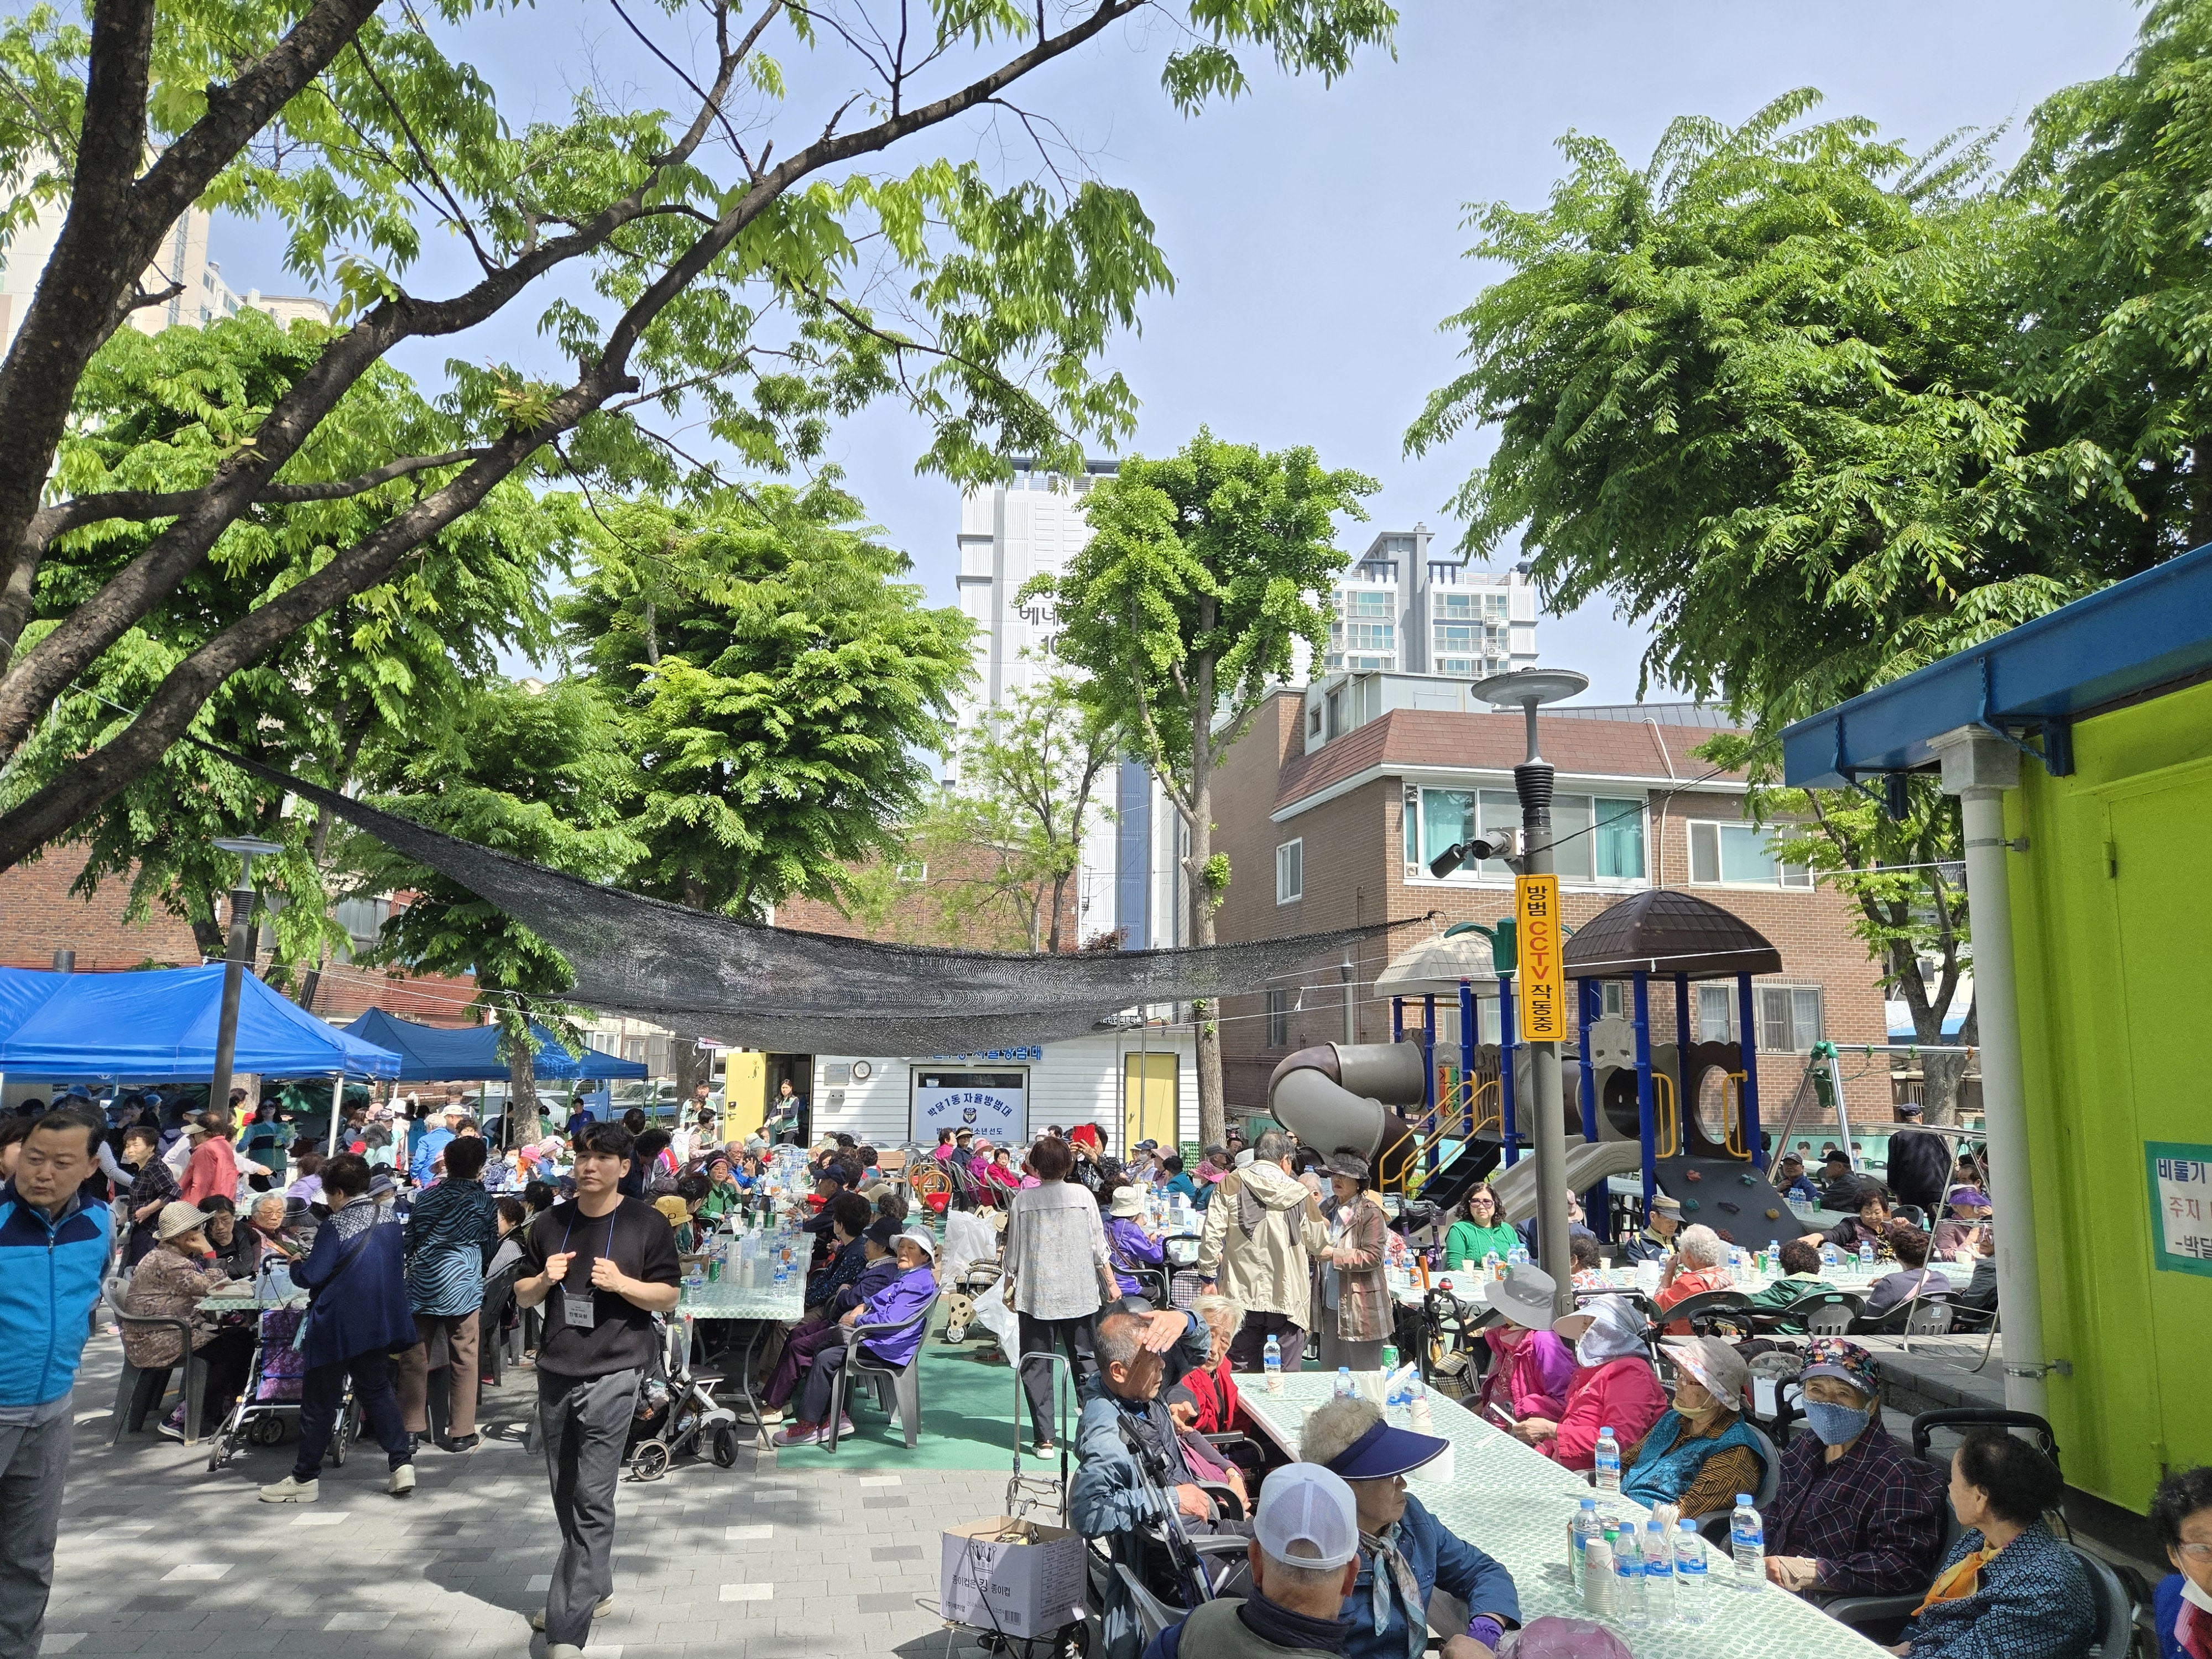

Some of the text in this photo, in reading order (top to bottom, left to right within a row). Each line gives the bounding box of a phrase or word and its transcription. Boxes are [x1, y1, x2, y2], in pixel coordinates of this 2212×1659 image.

[1527, 885, 1553, 1032] 방범 CCTV 작동중
[927, 1092, 1013, 1117] 박달1동 자율방범대
[2158, 1159, 2206, 1184] 비둘기
[2169, 1196, 2200, 1221] 주지
[952, 1574, 1010, 1597] 종이컵은 킹 종이컵
